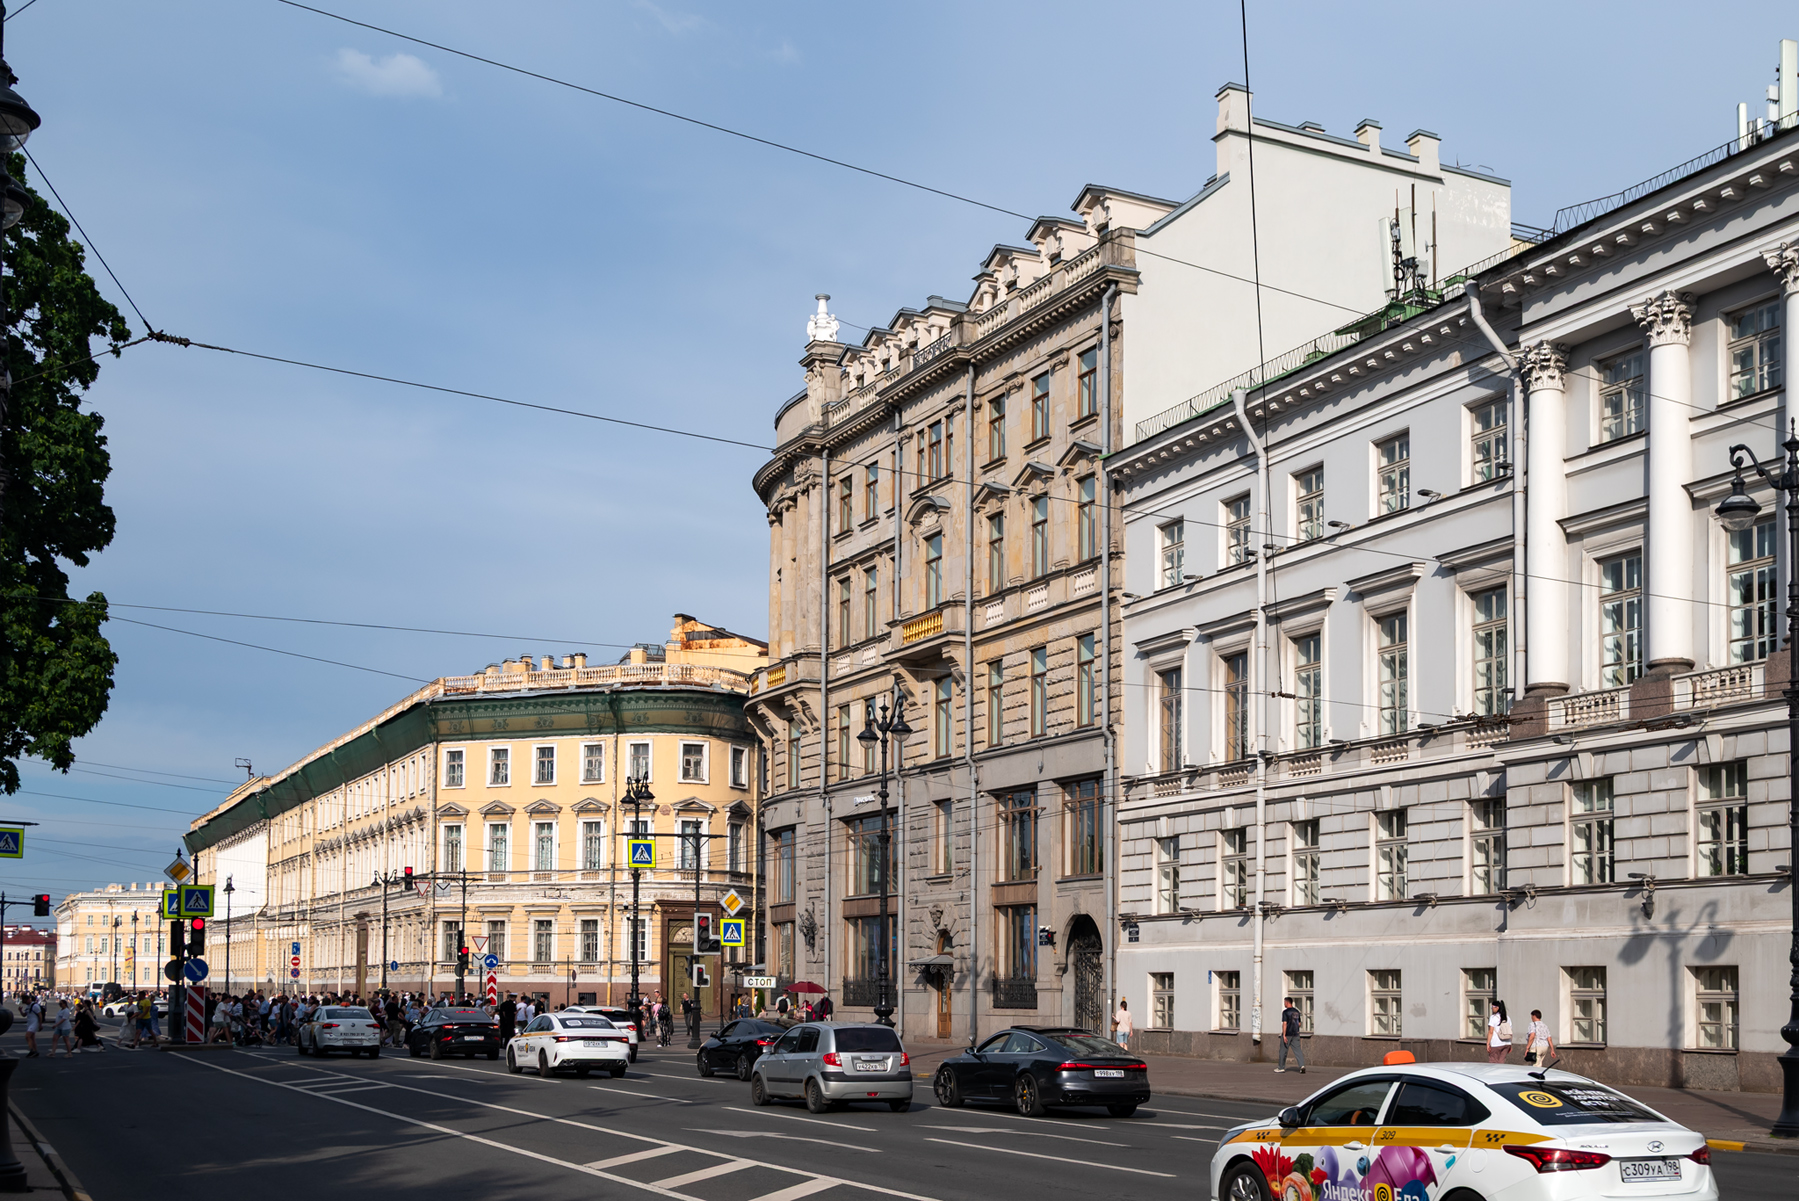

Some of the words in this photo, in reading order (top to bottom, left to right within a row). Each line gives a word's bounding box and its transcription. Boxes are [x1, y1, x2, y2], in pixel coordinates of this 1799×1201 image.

[748, 978, 772, 986] СТОП
[1380, 1131, 1396, 1140] 309
[1323, 1180, 1372, 1201] Яндекс
